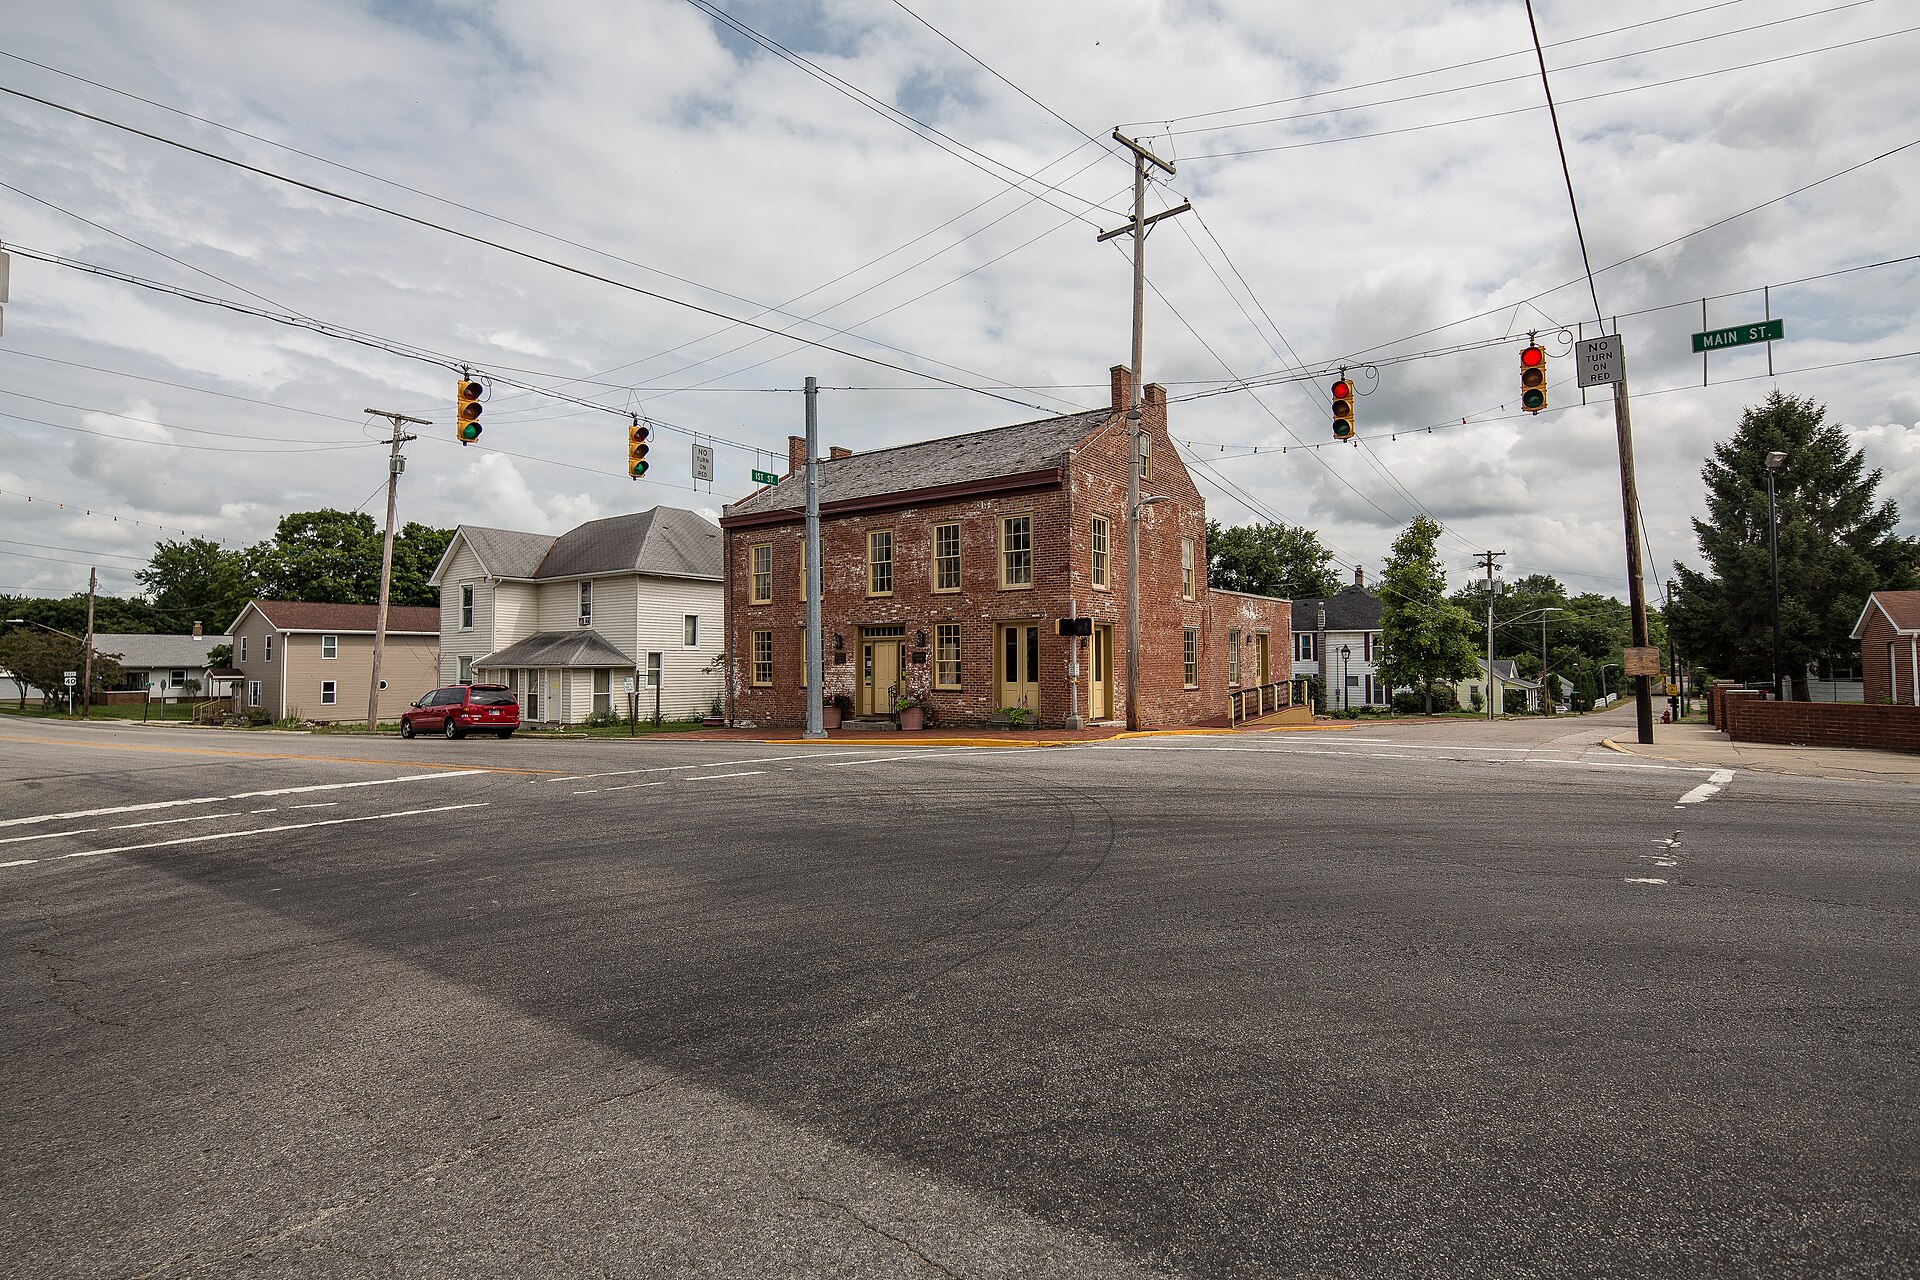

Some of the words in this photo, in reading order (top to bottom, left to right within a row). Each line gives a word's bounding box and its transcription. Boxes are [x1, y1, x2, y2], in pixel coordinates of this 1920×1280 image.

[1703, 331, 1738, 348] MAIN
[1749, 326, 1772, 340] ST.
[1588, 341, 1609, 353] NO
[1586, 352, 1613, 362] TURN
[1593, 362, 1607, 372] ON
[1590, 372, 1610, 382] RED
[698, 448, 708, 457] NO
[697, 456, 709, 464] TURN
[700, 463, 707, 471] ON
[698, 470, 708, 478] RED
[755, 472, 764, 481] 1ST
